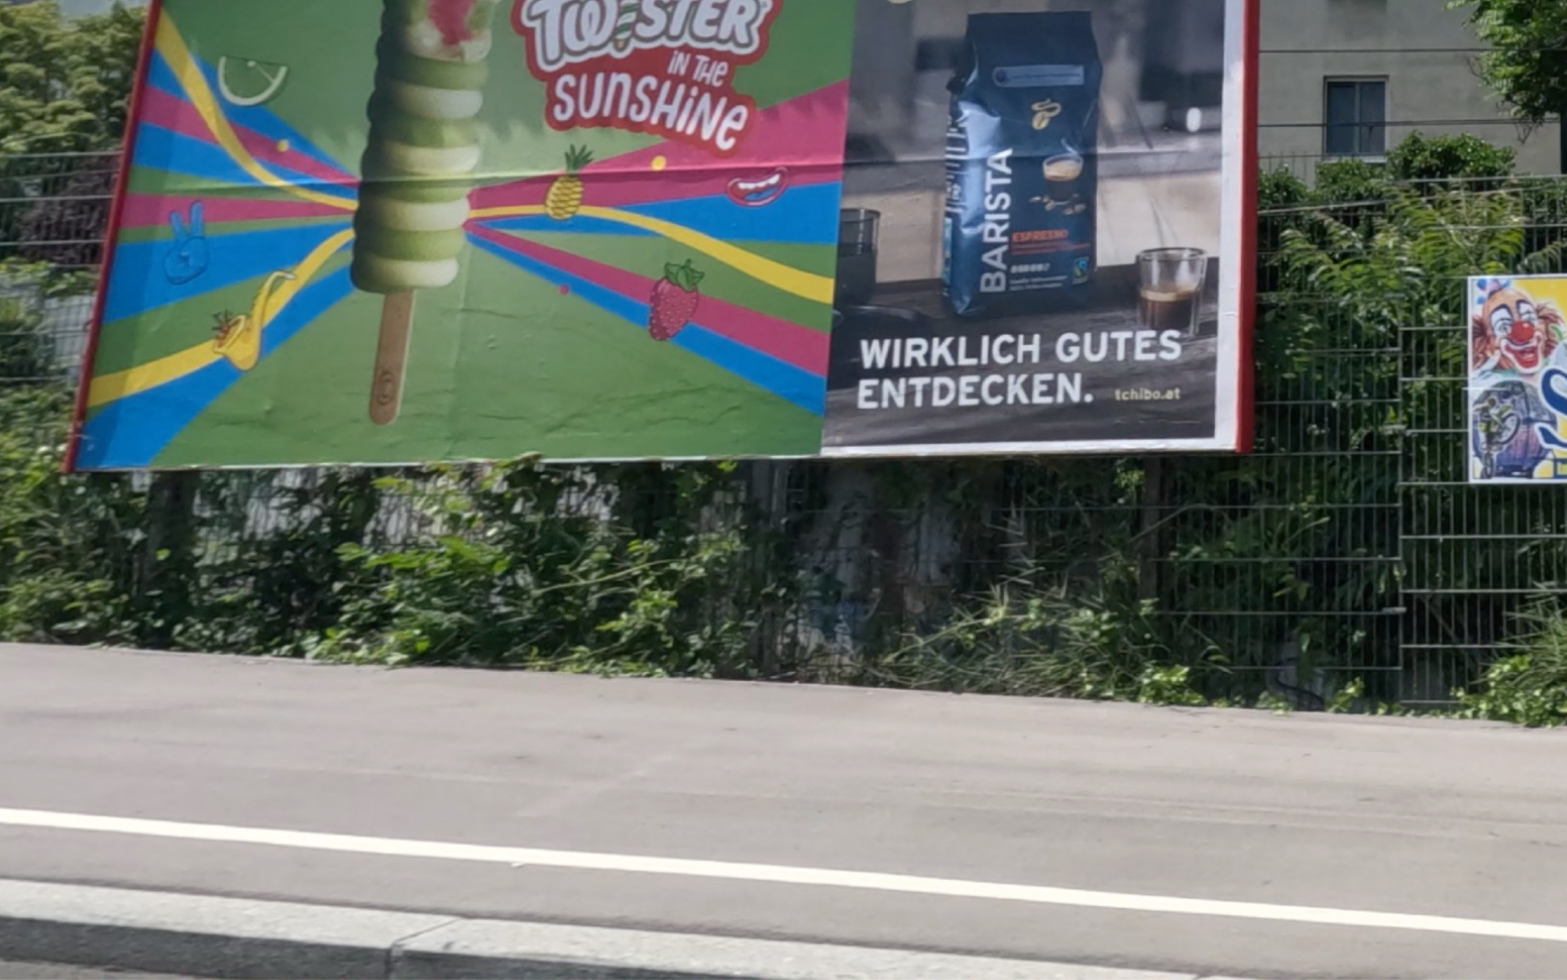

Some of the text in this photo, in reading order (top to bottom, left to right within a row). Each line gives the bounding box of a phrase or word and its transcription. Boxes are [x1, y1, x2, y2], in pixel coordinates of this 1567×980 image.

[979, 148, 1014, 293] BARISTA
[858, 329, 1183, 370] WIRKLICH GUTES
[857, 372, 1182, 410] ENTDECKEN. tchibo.at
